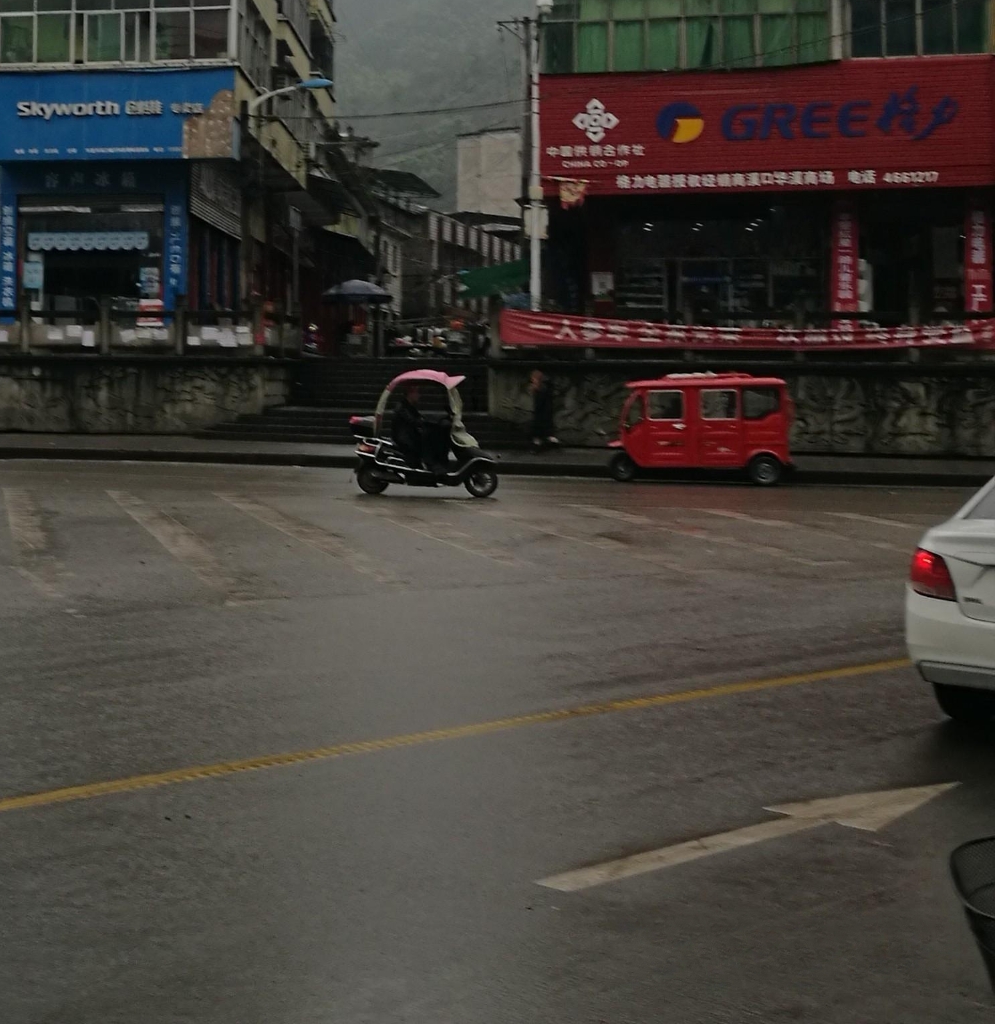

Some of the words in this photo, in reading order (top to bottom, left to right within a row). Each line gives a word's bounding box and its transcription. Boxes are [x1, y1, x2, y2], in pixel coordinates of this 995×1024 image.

[16, 100, 121, 120] Skyworth
[874, 84, 960, 141] 格力
[720, 100, 872, 142] GREE
[545, 144, 646, 159] 中国供销合作社
[847, 169, 876, 185] 电话
